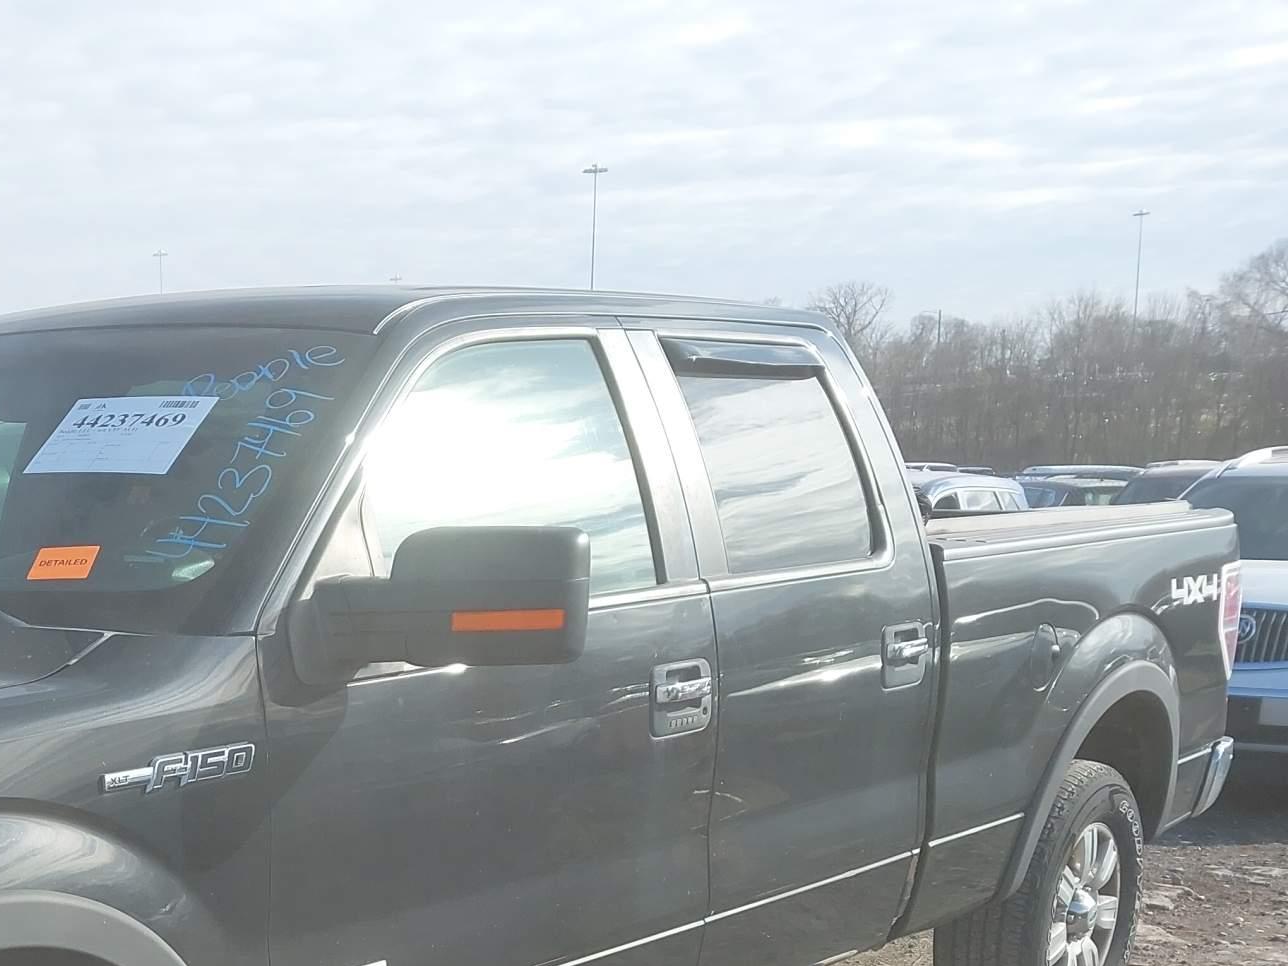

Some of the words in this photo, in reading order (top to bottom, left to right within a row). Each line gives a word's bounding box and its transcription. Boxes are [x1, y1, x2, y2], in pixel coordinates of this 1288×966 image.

[73, 412, 187, 430] 44237469
[39, 558, 88, 567] DETAILED
[109, 774, 131, 786] XLT
